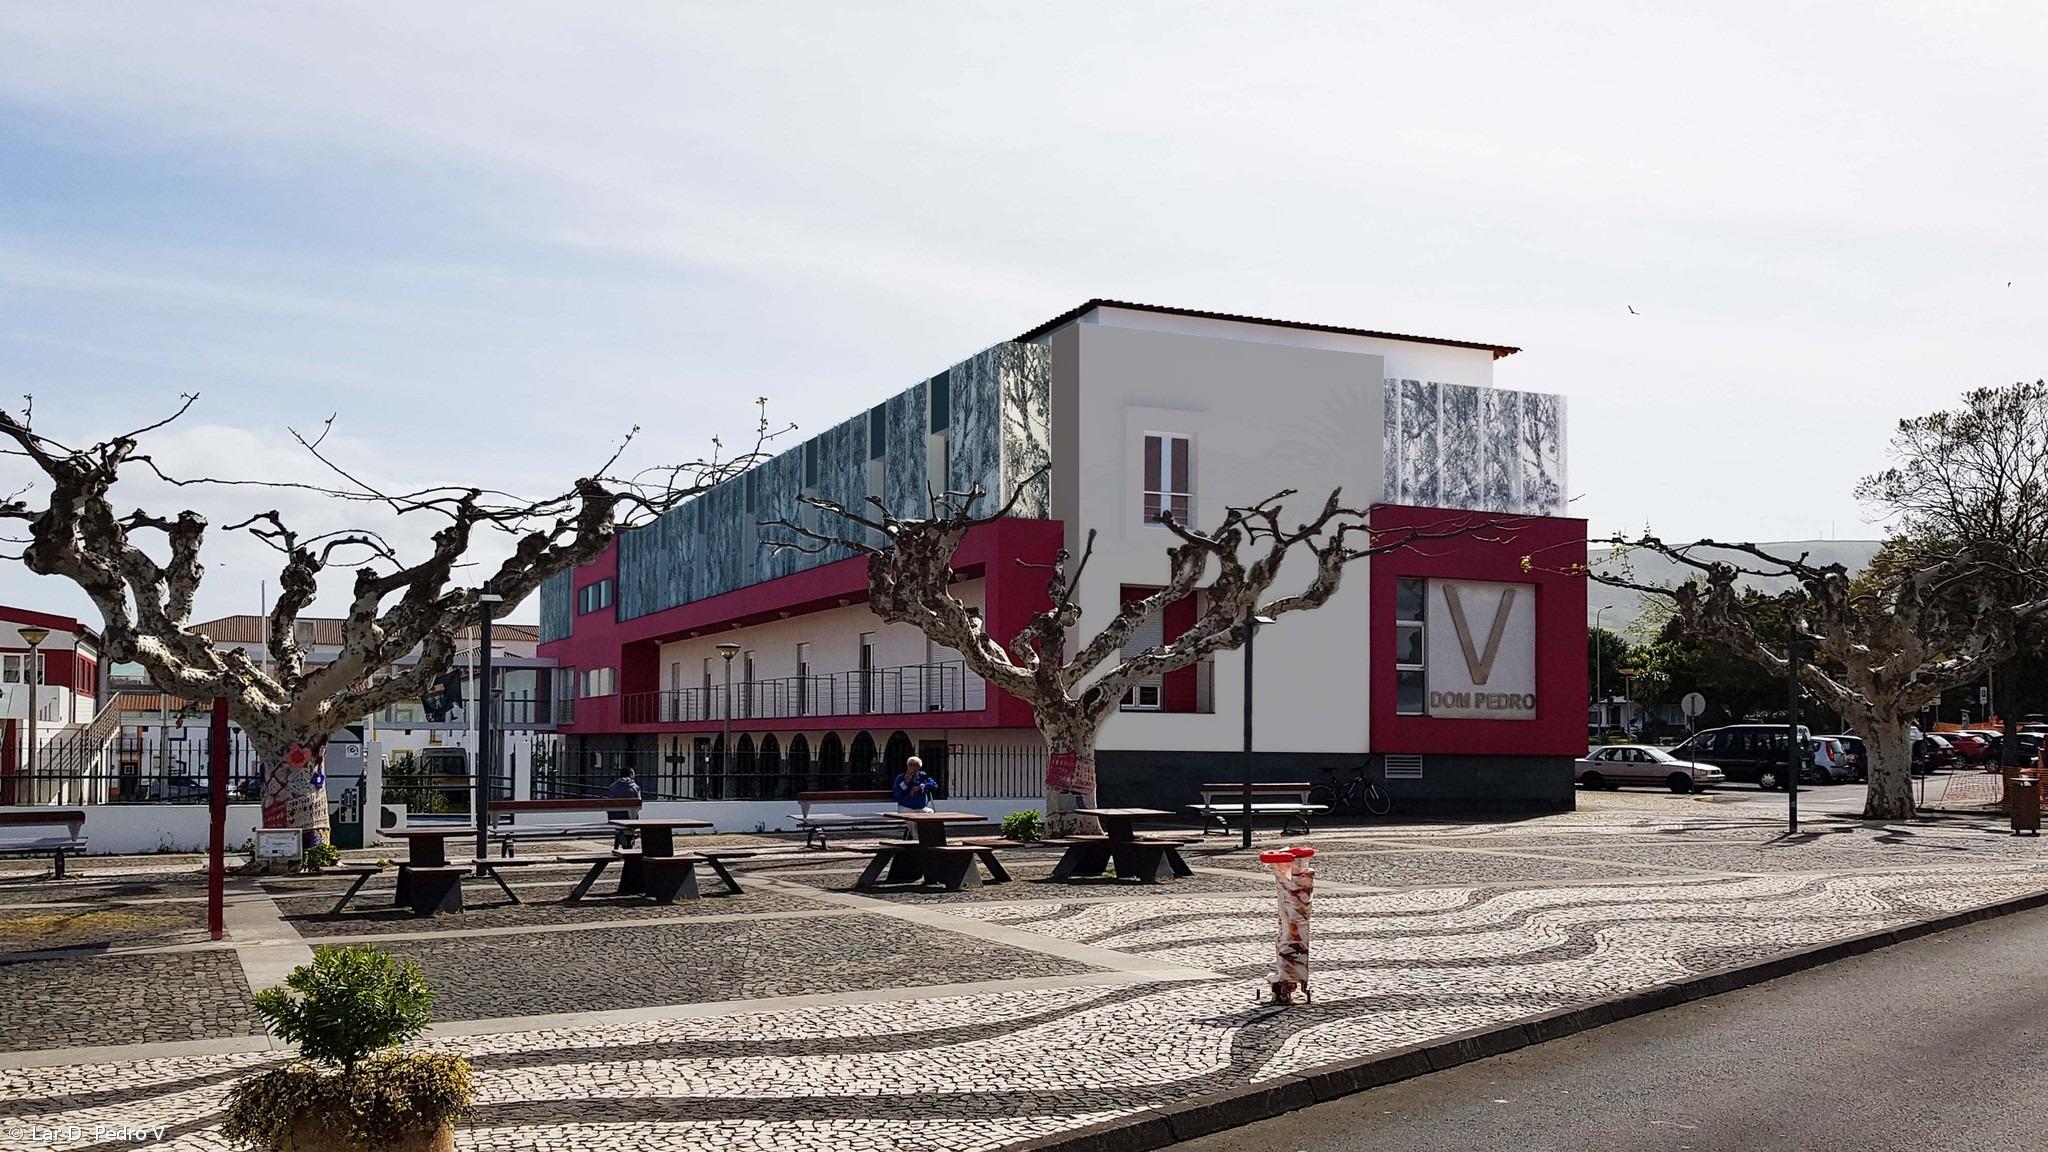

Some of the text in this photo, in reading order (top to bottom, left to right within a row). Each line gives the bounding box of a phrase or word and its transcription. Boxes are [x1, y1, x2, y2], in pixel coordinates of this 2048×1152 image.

[1442, 584, 1517, 685] V
[1430, 691, 1535, 710] DOM PEDRO
